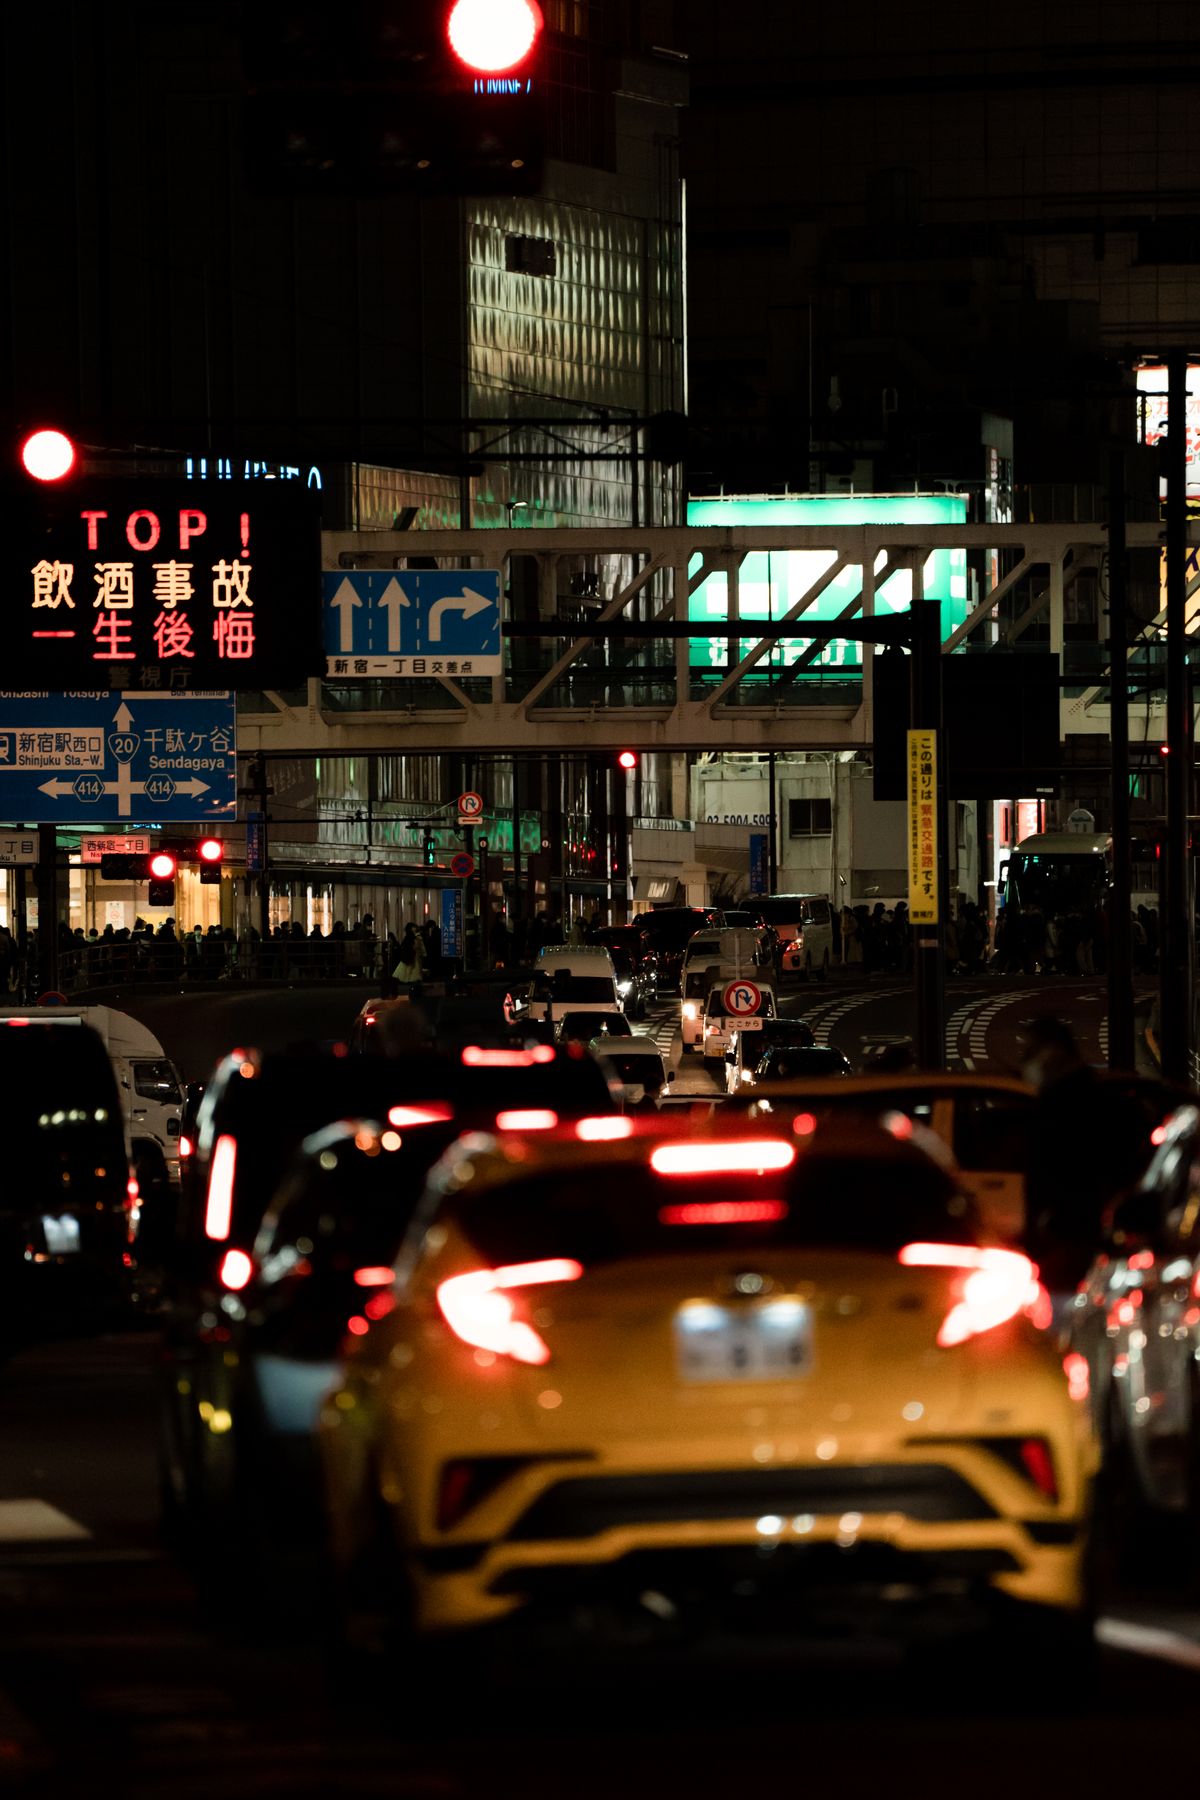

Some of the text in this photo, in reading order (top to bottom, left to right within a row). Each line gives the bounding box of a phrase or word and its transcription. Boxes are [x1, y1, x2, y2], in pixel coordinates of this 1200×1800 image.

[31, 559, 254, 609] 飲酒事故
[31, 611, 256, 659] 一生後悔
[326, 659, 473, 674] 新宿一丁目交差点
[109, 666, 193, 686] 警視庁
[19, 732, 101, 753] 新宿駅西口
[115, 738, 135, 754] 20
[18, 754, 61, 768] Shinjuku
[149, 755, 226, 772] Sendagaya
[77, 781, 100, 796] 414
[149, 781, 172, 796] 414
[5, 840, 33, 854] 丁目
[87, 839, 144, 852] 西新宿一丁目
[728, 1020, 760, 1028] ここから
